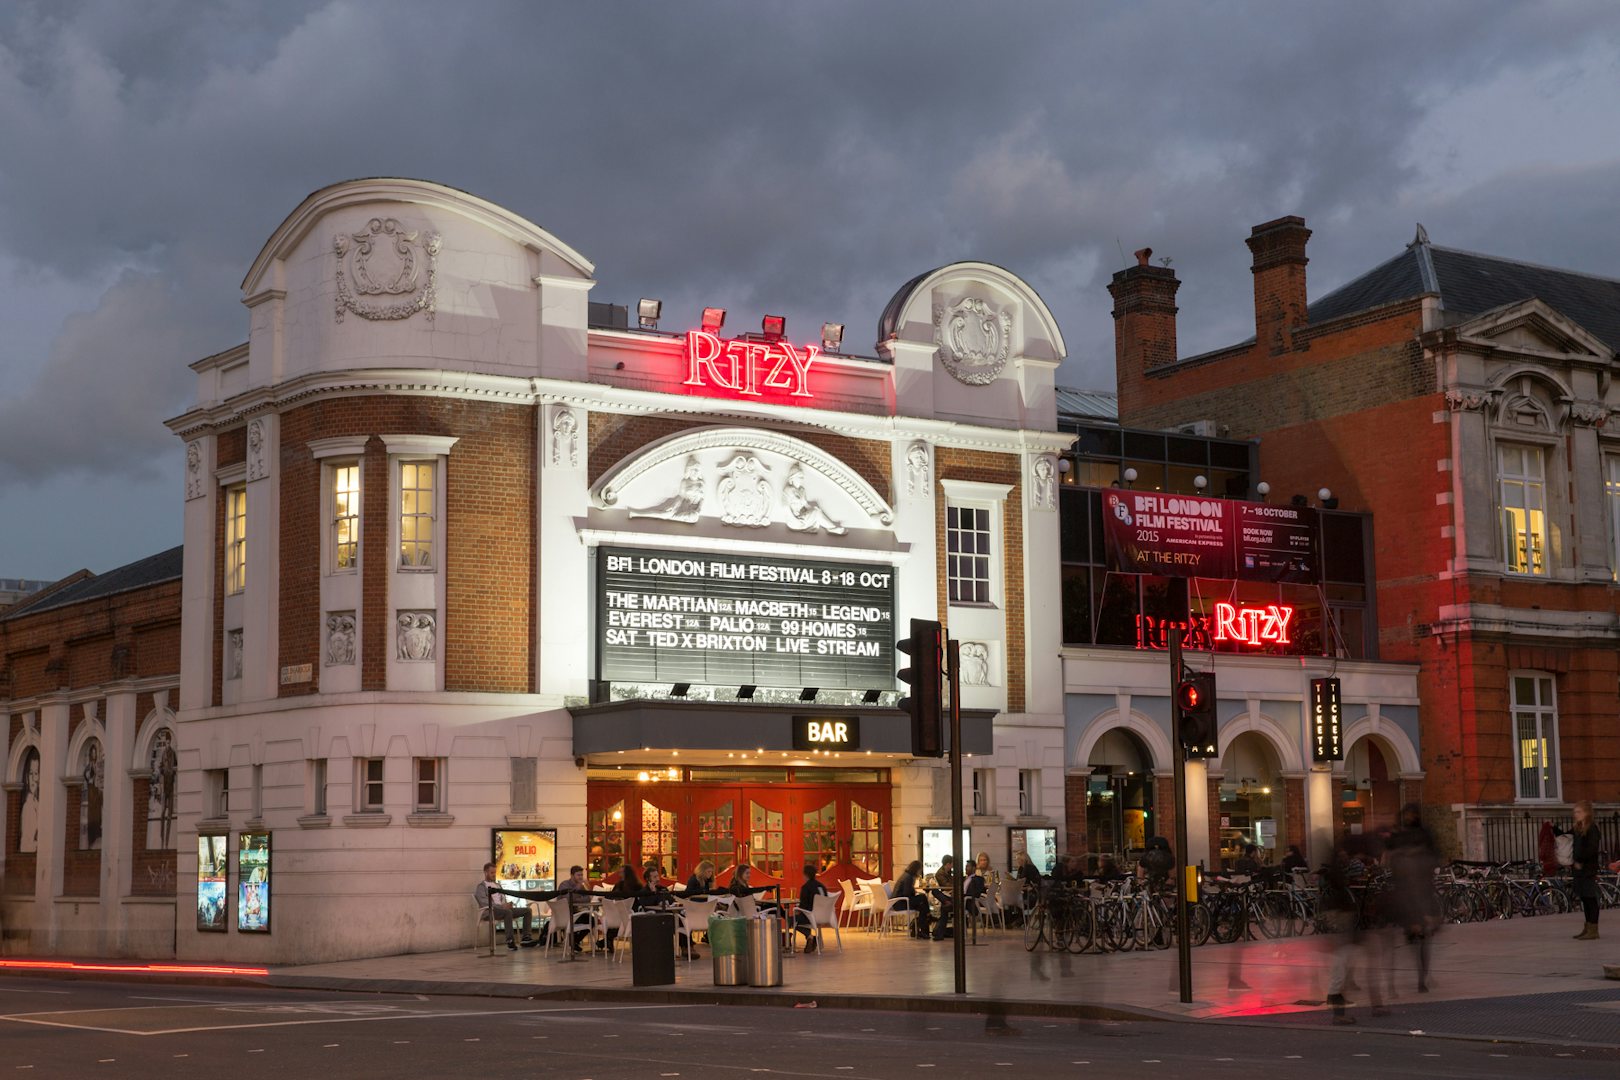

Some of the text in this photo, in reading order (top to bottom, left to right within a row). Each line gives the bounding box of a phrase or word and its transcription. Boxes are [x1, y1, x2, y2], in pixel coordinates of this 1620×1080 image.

[1135, 496, 1222, 518] BFI LONDON
[1263, 508, 1298, 519] OCTOBER
[1135, 514, 1223, 532] FILM FESTIVAL
[1136, 530, 1159, 542] 2015
[1137, 550, 1201, 565] AT THE RITZY
[607, 555, 632, 572] BFI
[640, 558, 705, 577] LONDON
[710, 562, 745, 580] FILM
[749, 564, 818, 584] FESTIVAL
[859, 572, 890, 589] OCT
[606, 592, 638, 609] THE
[643, 594, 718, 614] MARTIAN
[719, 602, 732, 612] 12A
[735, 601, 808, 617] MACBETH
[822, 605, 880, 622] LEGEND
[609, 611, 683, 629] EVEREST
[685, 619, 700, 628] 12A
[710, 616, 754, 634] PALIO
[757, 622, 770, 631] 12A
[781, 621, 799, 635] 99
[802, 623, 856, 638] HOMES
[606, 630, 880, 657] SAT TED X BRIXTON LIVE STREAM
[1315, 684, 1324, 755] TICKETS
[1331, 684, 1339, 755] TICKETS
[807, 722, 848, 743] BAR
[514, 845, 536, 855] PALIO
